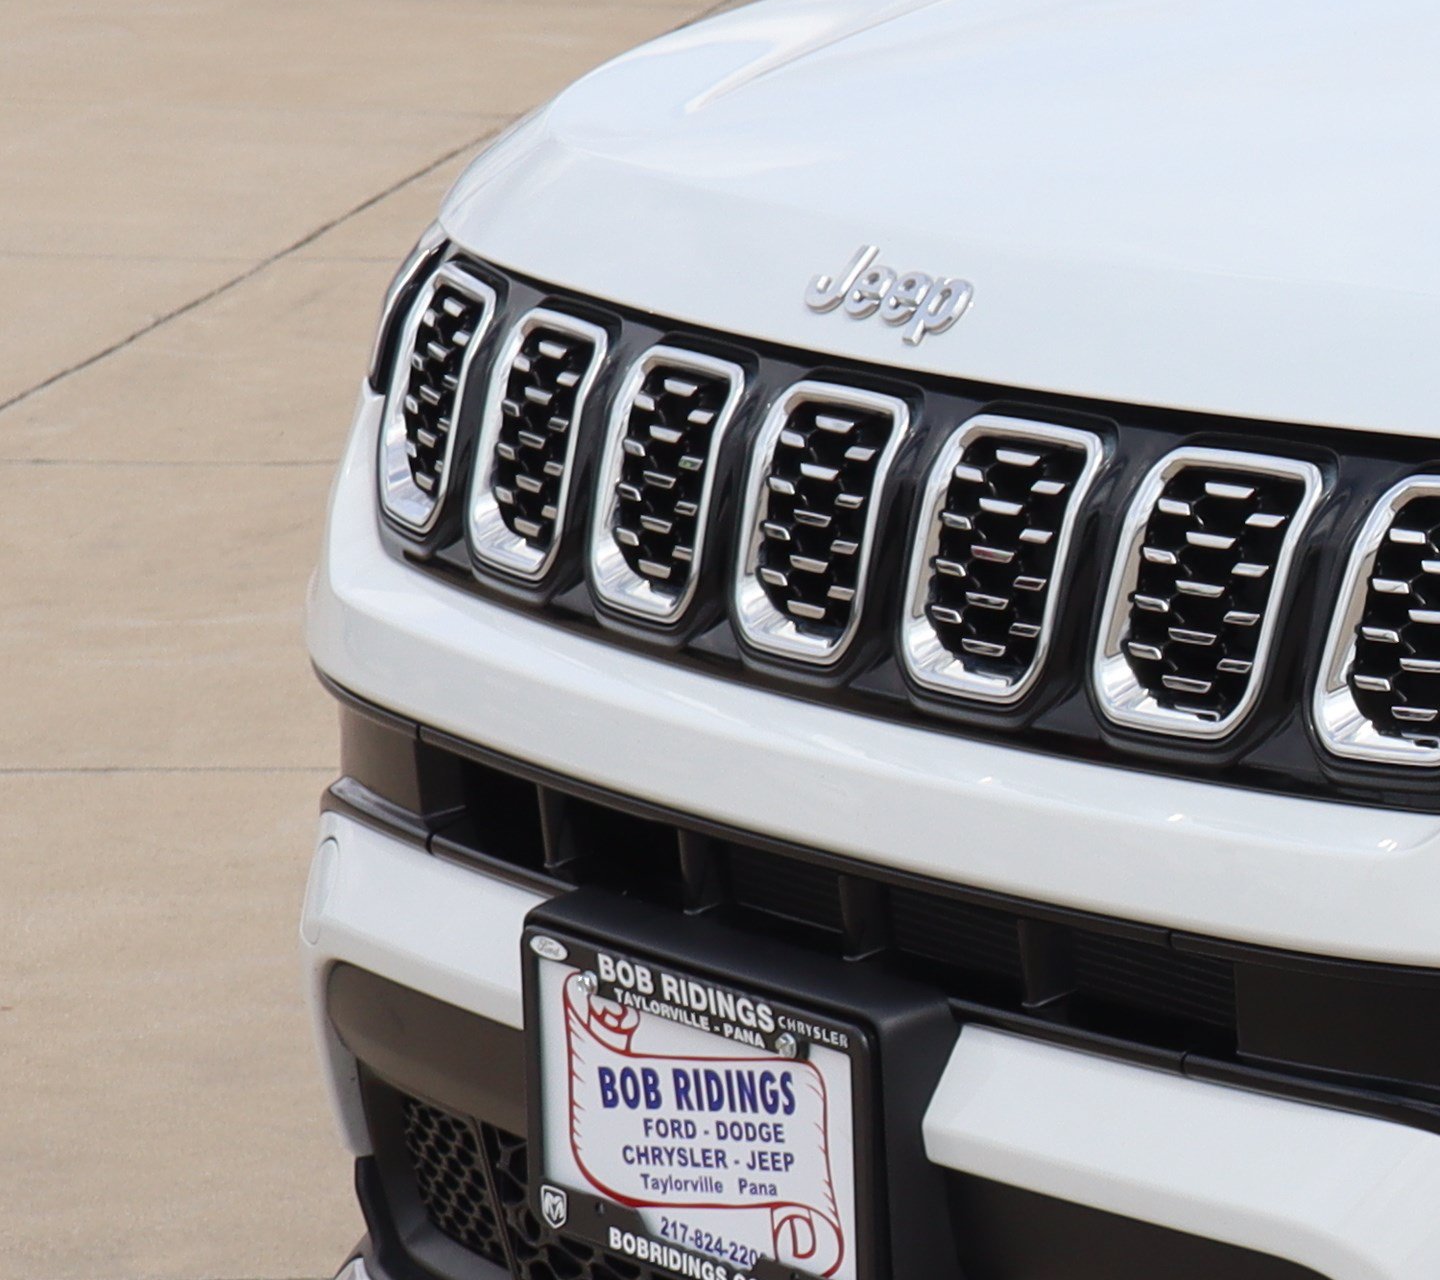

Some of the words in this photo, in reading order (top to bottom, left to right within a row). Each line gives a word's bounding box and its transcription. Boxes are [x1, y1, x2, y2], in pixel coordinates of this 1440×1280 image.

[804, 244, 974, 347] Jeep
[536, 939, 562, 958] Ford
[597, 952, 655, 995] BOB
[660, 972, 776, 1034] RIDINGS
[613, 987, 711, 1032] TAYLORVILLE
[723, 1022, 766, 1050] PANA
[777, 1014, 849, 1049] CHRYSLER
[597, 1066, 662, 1110] BOB
[671, 1068, 796, 1116] RIDINGS
[642, 1118, 697, 1140] FORD
[715, 1120, 786, 1144] DODGE
[621, 1144, 729, 1170] CHRYSLER
[746, 1150, 795, 1172] JEEP
[640, 1173, 724, 1195] Taylorville
[738, 1177, 778, 1197] Pana
